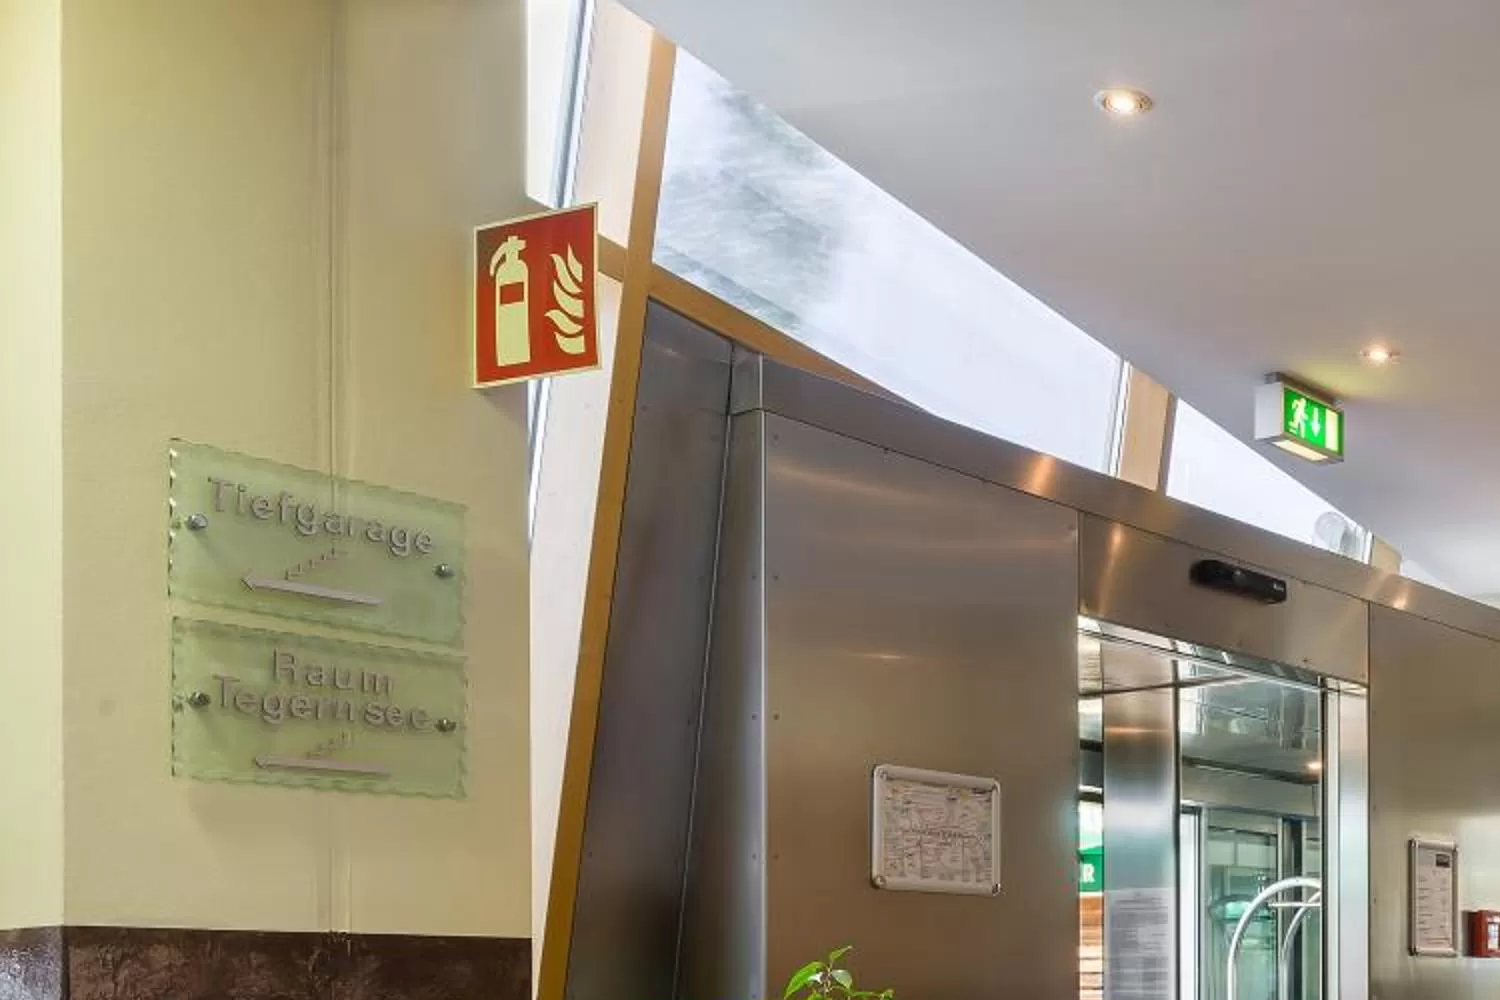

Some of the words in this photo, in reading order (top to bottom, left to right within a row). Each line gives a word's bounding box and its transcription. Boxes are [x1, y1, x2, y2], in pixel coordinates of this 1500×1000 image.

[207, 475, 434, 557] Tiefgarage
[273, 648, 393, 696] Raum
[212, 673, 434, 733] Tegernsee
